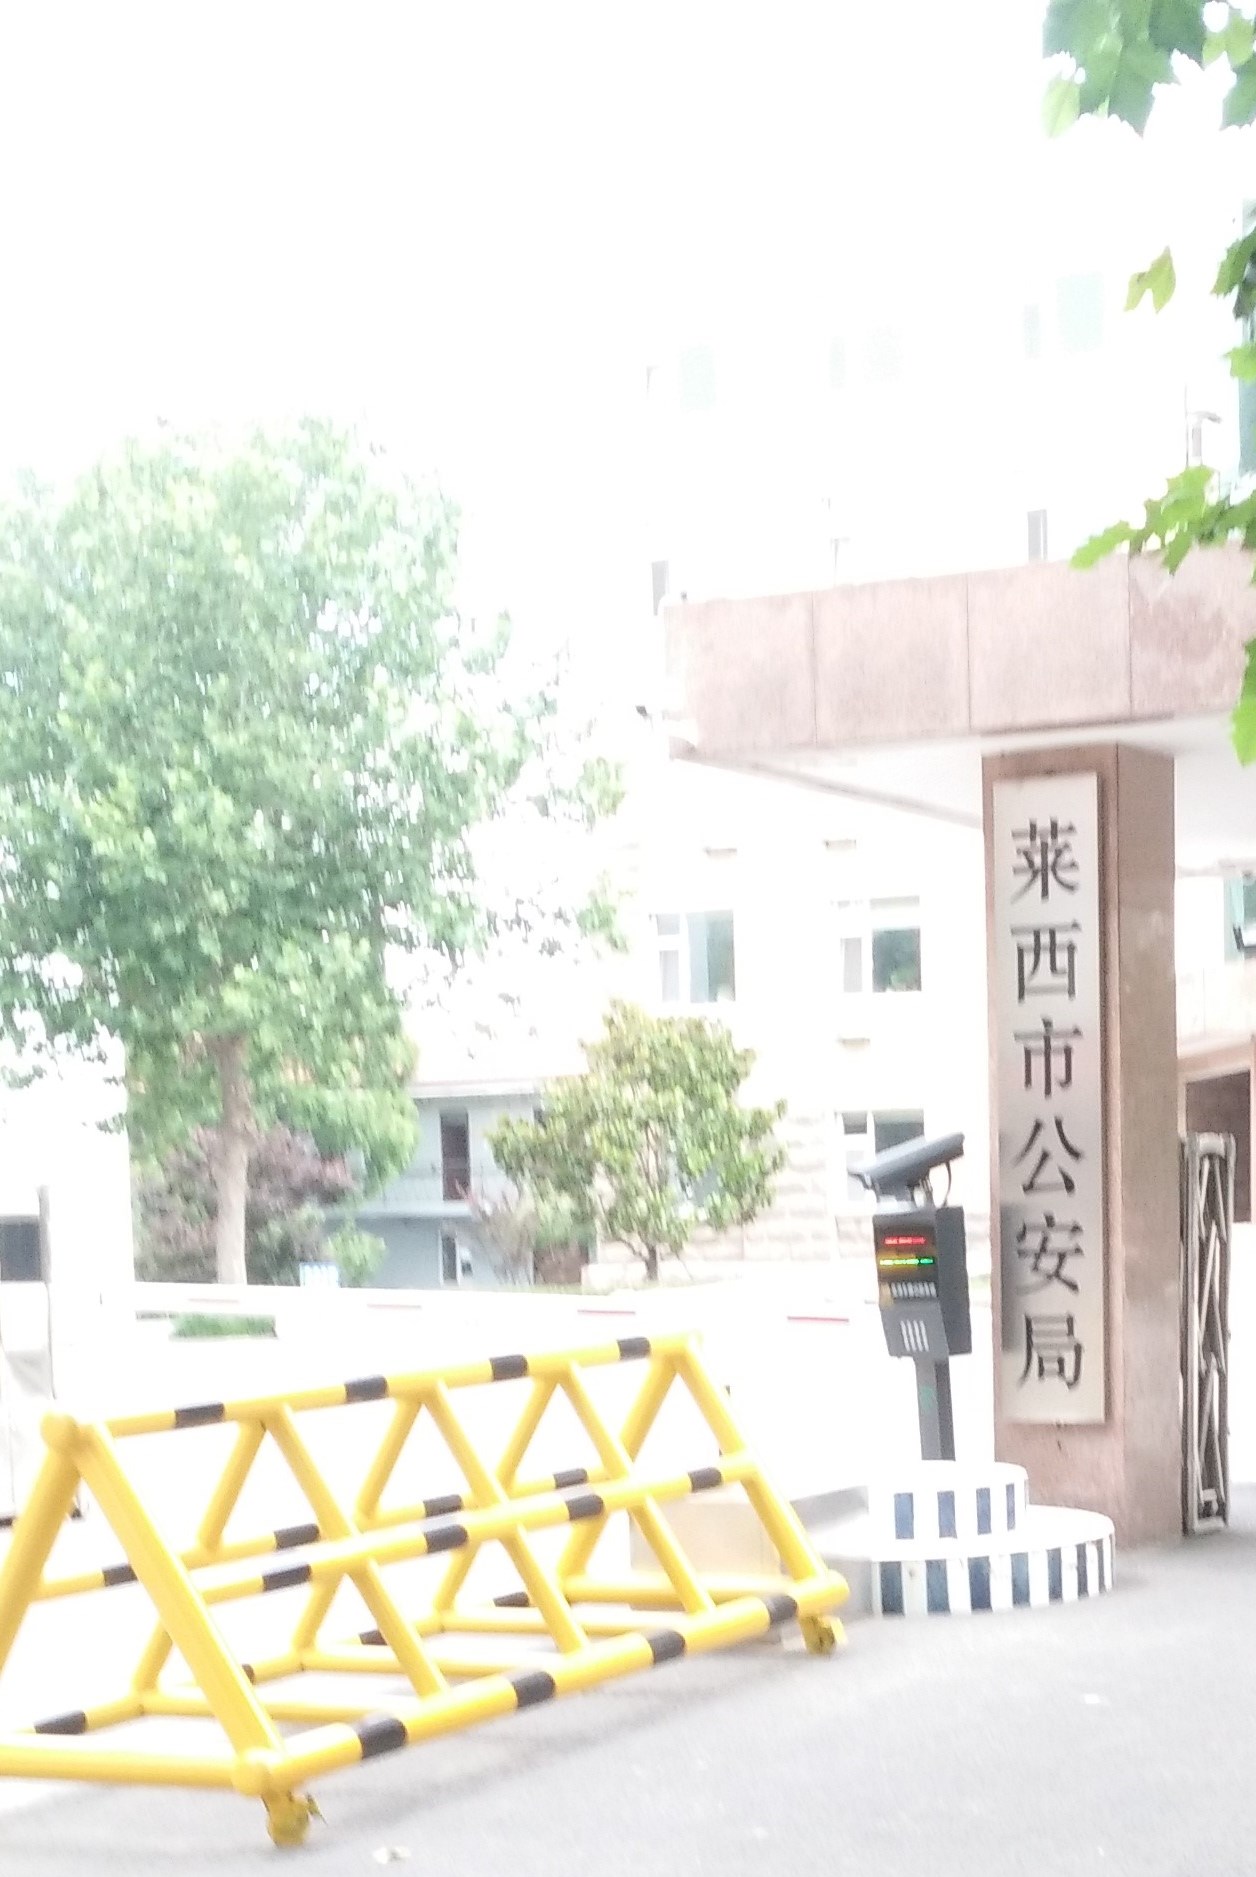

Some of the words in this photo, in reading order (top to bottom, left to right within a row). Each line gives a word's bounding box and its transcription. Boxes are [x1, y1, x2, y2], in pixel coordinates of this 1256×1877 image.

[1010, 817, 1084, 1391] 莱西市公安局
